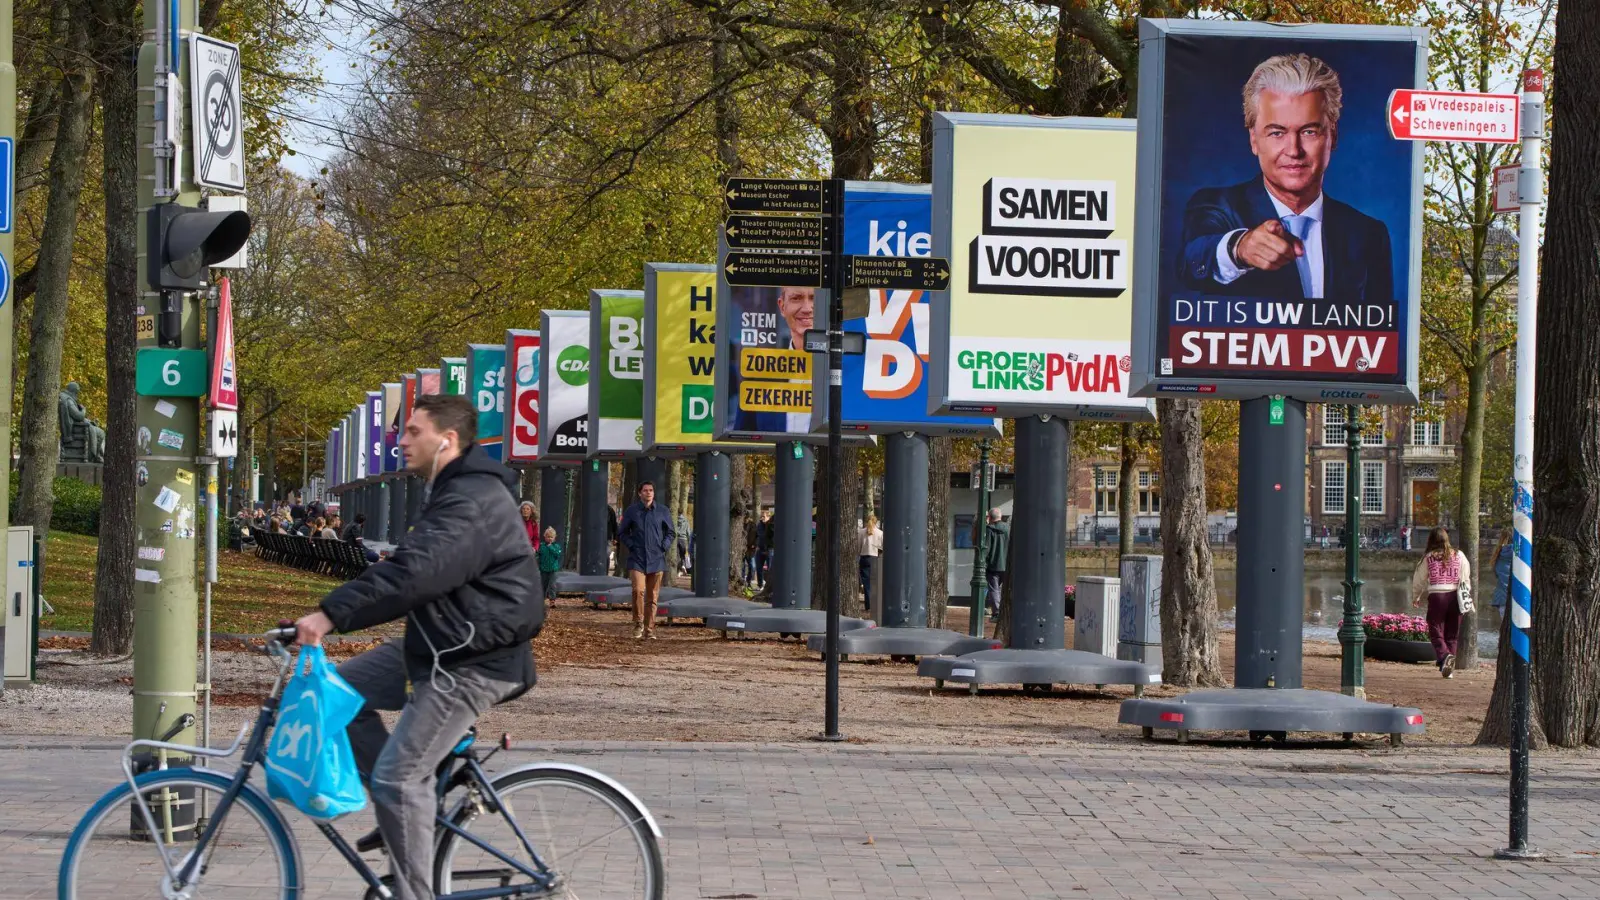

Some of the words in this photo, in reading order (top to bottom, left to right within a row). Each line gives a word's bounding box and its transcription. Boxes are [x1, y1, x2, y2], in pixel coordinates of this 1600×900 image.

[208, 49, 228, 67] ZONE
[210, 97, 231, 131] 30
[1429, 98, 1505, 114] Vredespaleis
[1413, 117, 1497, 136] Scheveningen
[1500, 123, 1507, 133] 3
[741, 182, 762, 191] Lange
[764, 183, 797, 191] Voorhout
[999, 187, 1108, 222] SAMEN
[741, 220, 766, 228] Theater
[767, 220, 801, 230] Diligentia
[741, 228, 770, 237] Theater
[771, 229, 796, 239] Pepijn
[868, 220, 931, 257] kie
[741, 257, 775, 265] Nationaal
[776, 257, 800, 266] Toneel
[769, 266, 793, 274] Station
[855, 259, 896, 268] Binnenhof
[985, 245, 1121, 280] VOORUIT
[854, 276, 881, 284] Politie
[923, 279, 935, 287] 0,7
[855, 268, 903, 277] Mauritshuis
[690, 285, 712, 312] H
[741, 312, 777, 328] STEM
[1175, 299, 1218, 323] DIT
[1226, 301, 1247, 324] IS
[1255, 302, 1304, 325] UW
[1311, 303, 1393, 328] LAND!
[609, 316, 644, 350] B
[1181, 331, 1290, 366] STEM
[1303, 334, 1387, 369] PVV
[162, 360, 181, 386] 6
[450, 365, 467, 382] PA
[614, 356, 644, 373] LE
[746, 355, 807, 374] ZORGEN
[957, 350, 1045, 371] GROEN
[1046, 353, 1121, 393] PvdA
[972, 371, 1044, 391] LINKS
[745, 388, 813, 407] ZEKERHE
[1321, 389, 1366, 399] trotter
[689, 396, 715, 420] D
[556, 435, 589, 446] Bon
